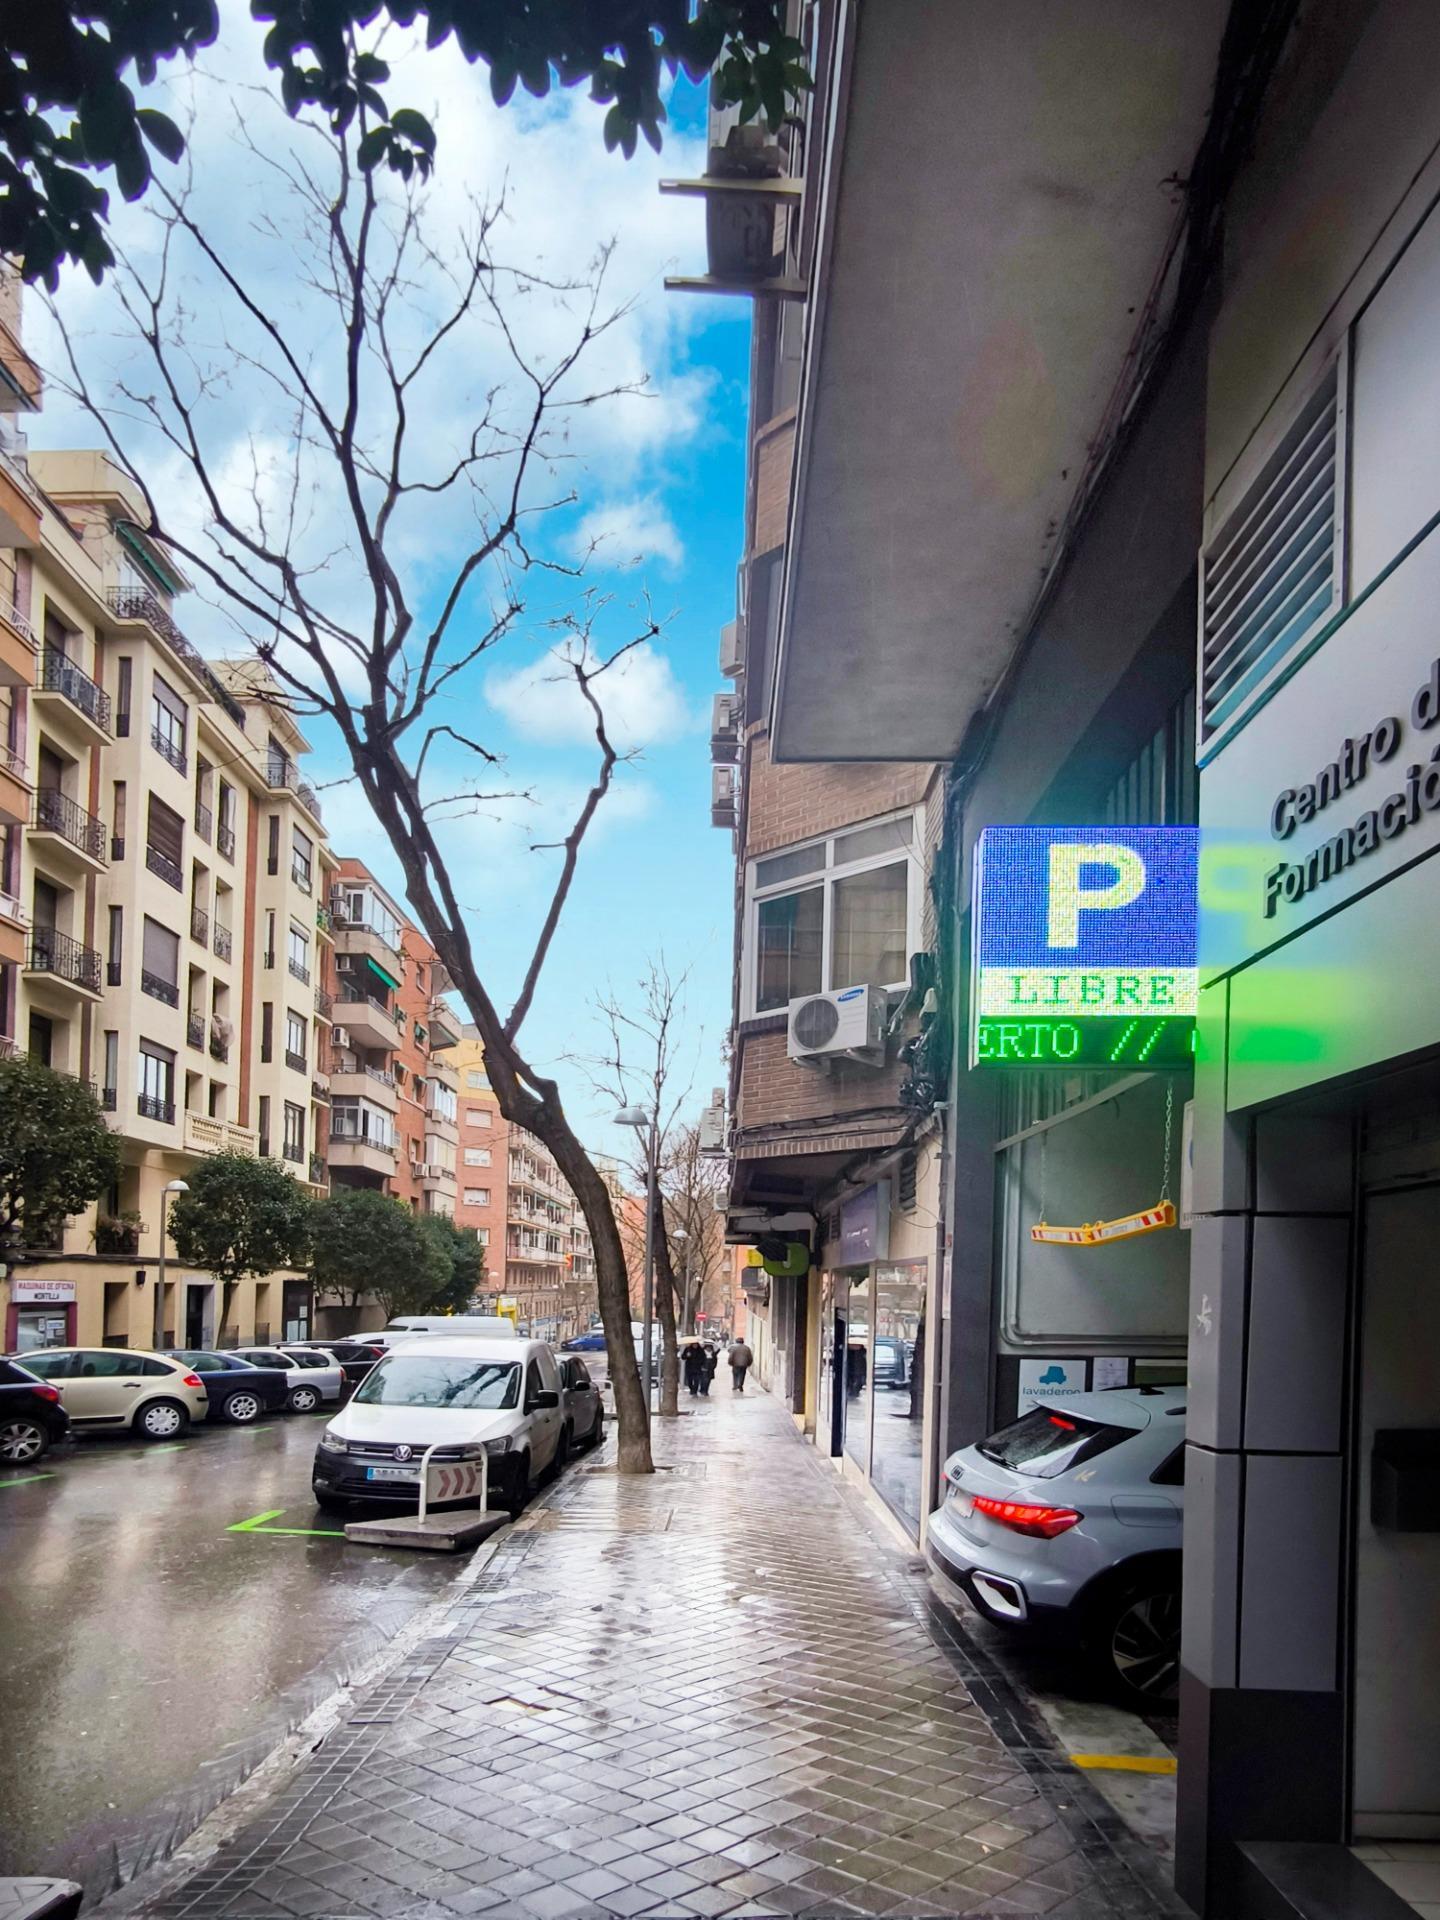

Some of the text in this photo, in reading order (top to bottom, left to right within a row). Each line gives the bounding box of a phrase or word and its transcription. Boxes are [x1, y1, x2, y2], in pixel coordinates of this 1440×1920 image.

[1270, 716, 1402, 842] Centro
[1047, 842, 1147, 948] P
[1008, 975, 1175, 1005] LIBRE
